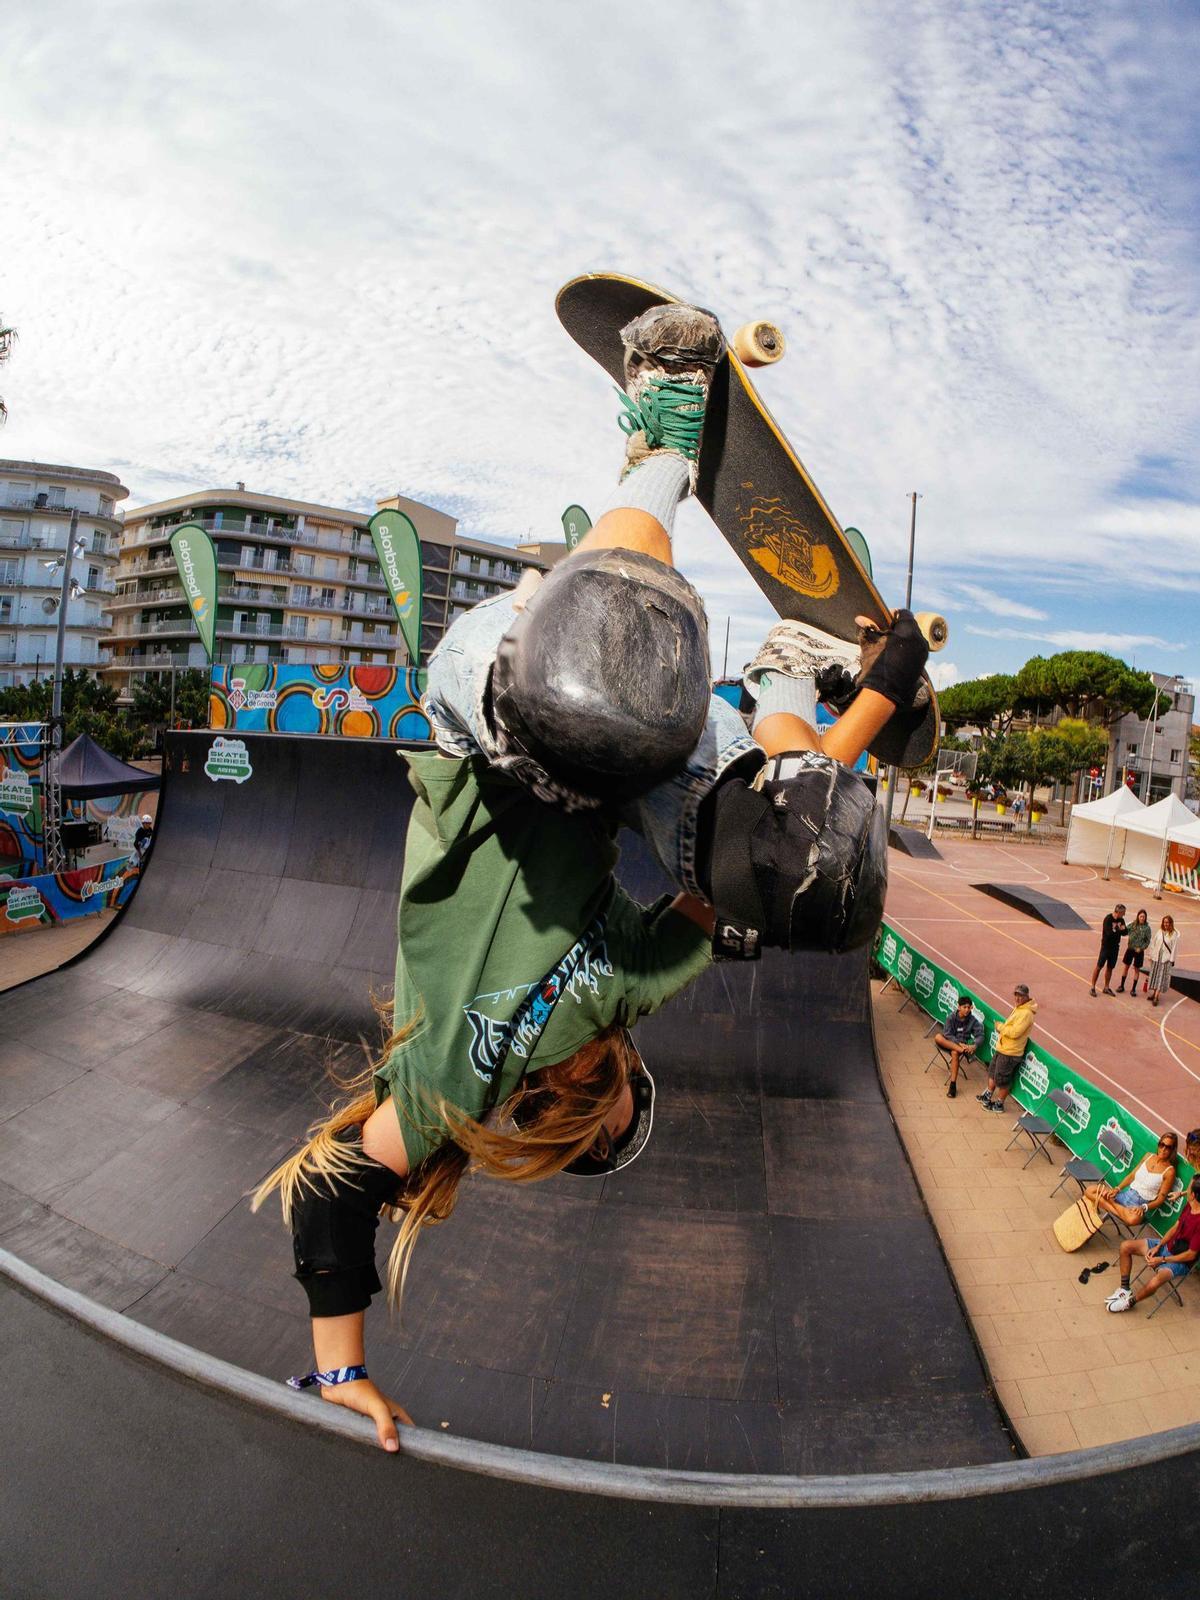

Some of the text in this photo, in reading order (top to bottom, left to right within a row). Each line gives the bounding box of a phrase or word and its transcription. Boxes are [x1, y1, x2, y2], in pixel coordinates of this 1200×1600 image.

[210, 751, 247, 759] SKATE
[210, 757, 247, 765] SERIES
[0, 784, 32, 794] KATE
[0, 793, 32, 803] ERIES
